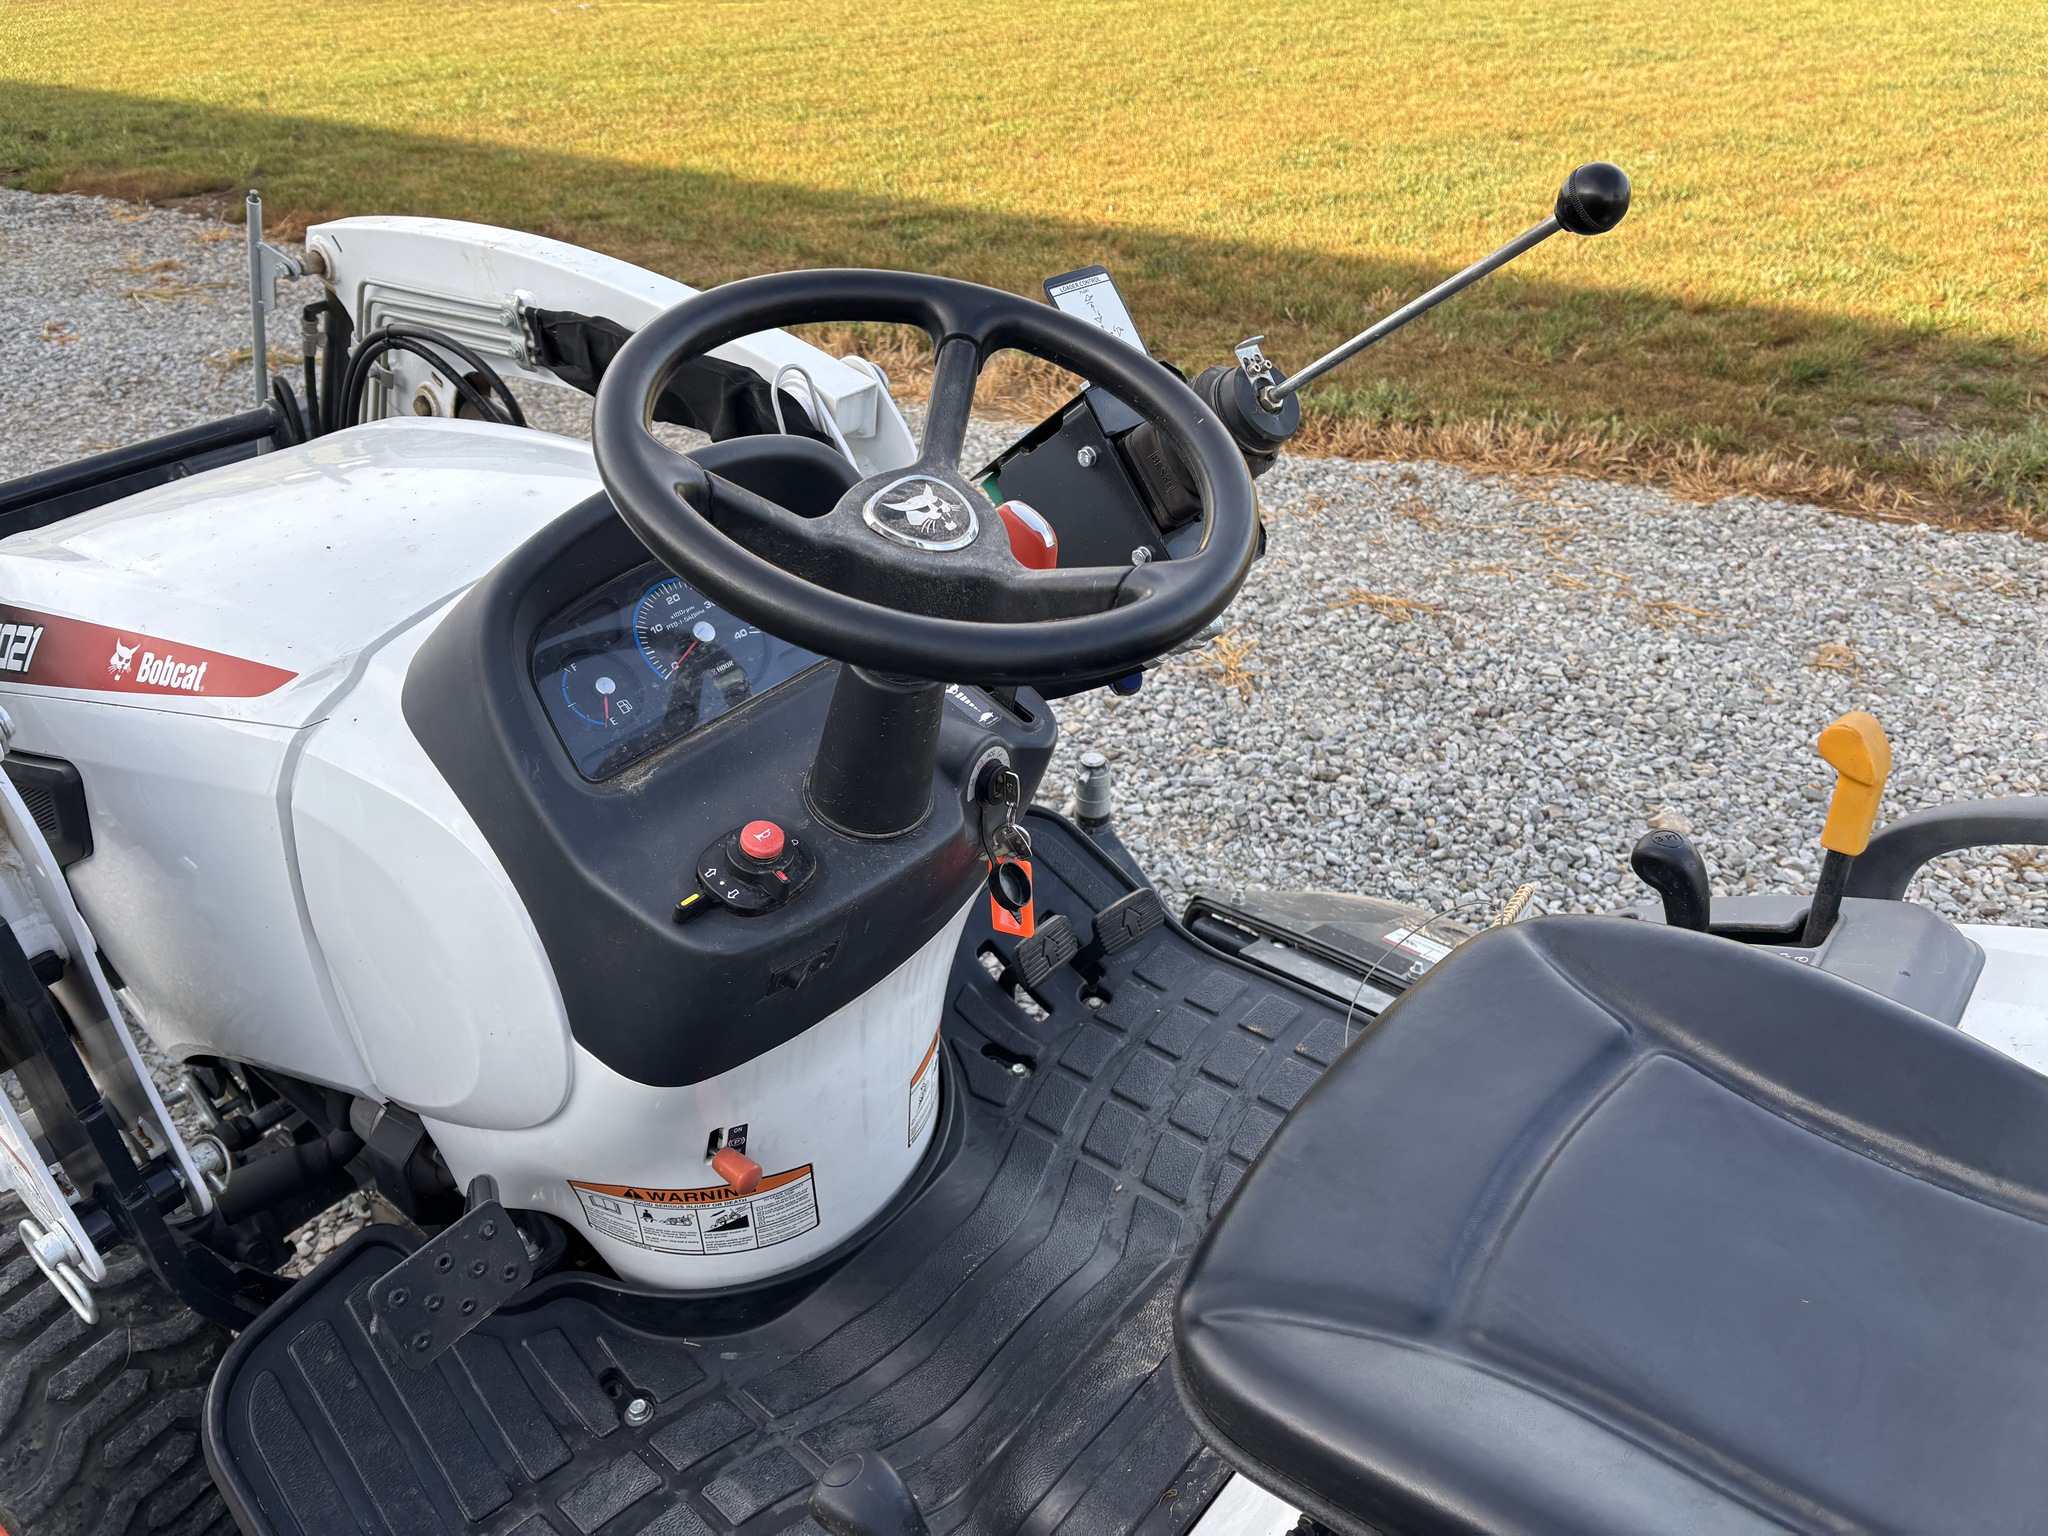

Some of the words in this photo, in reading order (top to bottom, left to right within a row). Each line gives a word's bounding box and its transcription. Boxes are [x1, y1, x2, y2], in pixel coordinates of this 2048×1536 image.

[1060, 282, 1079, 292] LOADER
[1079, 276, 1101, 286] CONTROL
[666, 593, 680, 605] 20
[704, 600, 716, 609] 3
[650, 623, 663, 634] 10
[734, 628, 748, 640] 40
[0, 623, 44, 673] 021
[136, 651, 208, 692] Bobcat
[570, 662, 577, 672] F
[716, 660, 734, 672] HOUR
[610, 716, 618, 726] E
[646, 1188, 756, 1202] WARNIN
[724, 1198, 748, 1206] DEATH
